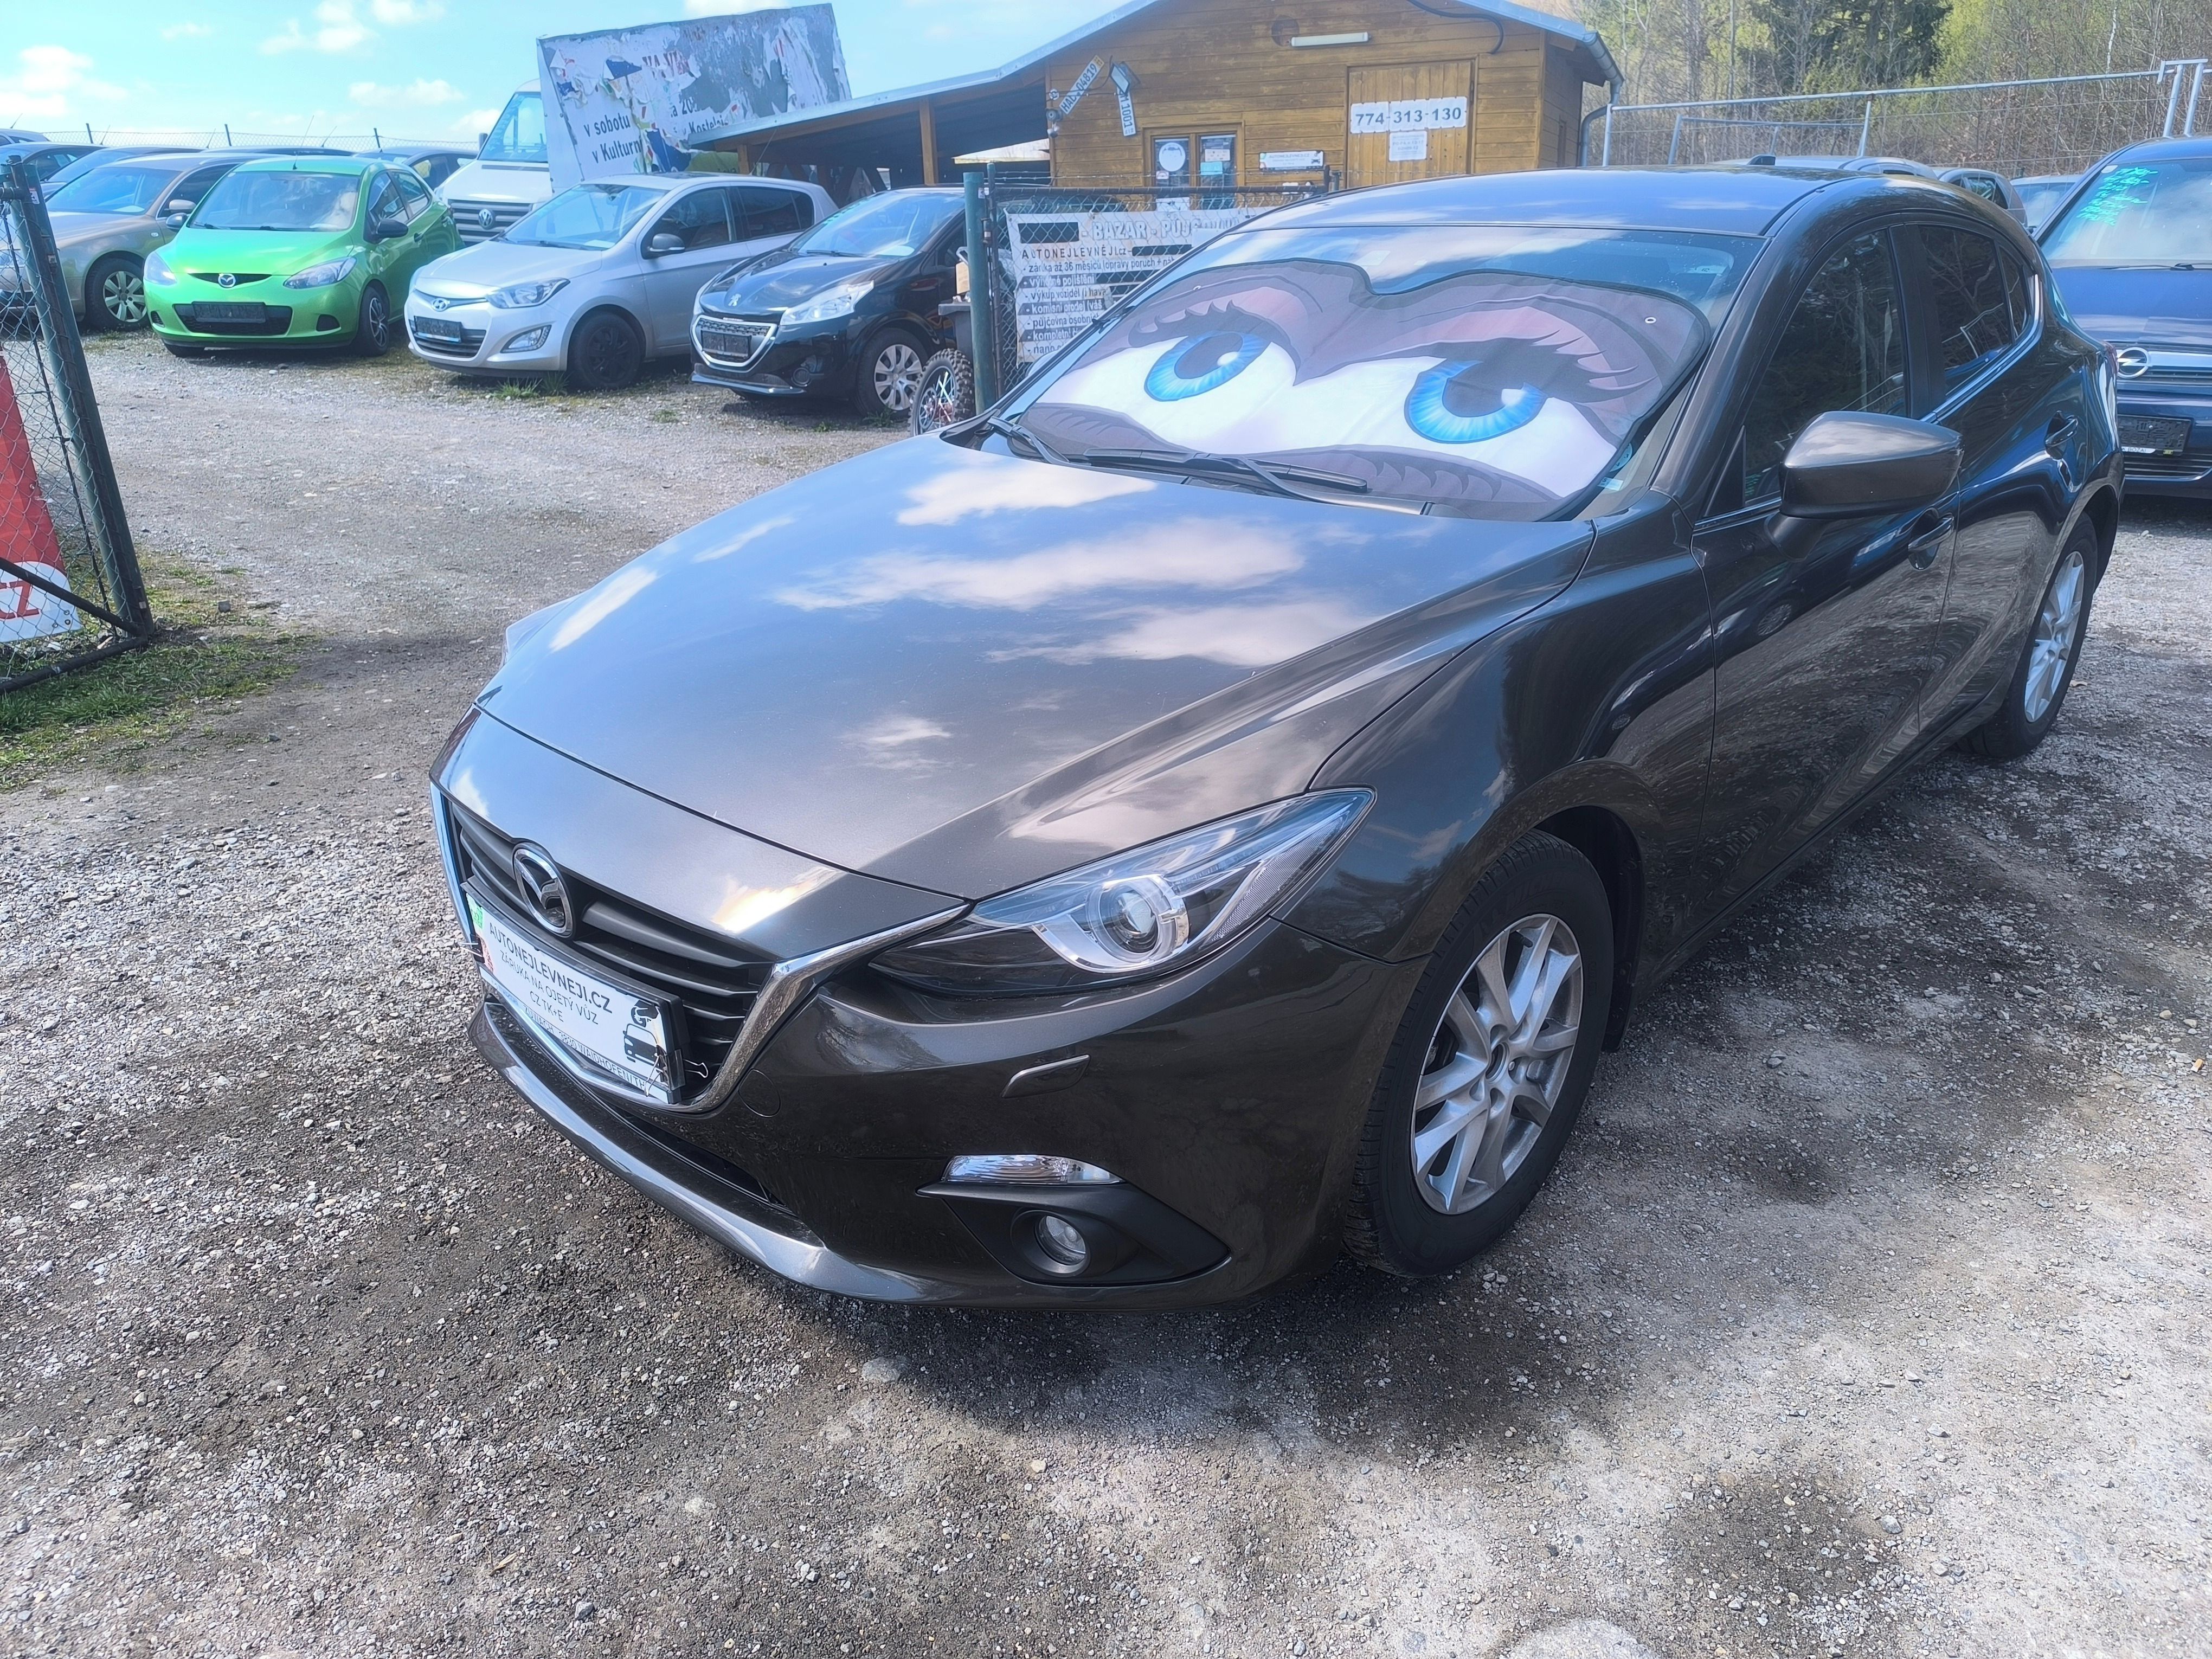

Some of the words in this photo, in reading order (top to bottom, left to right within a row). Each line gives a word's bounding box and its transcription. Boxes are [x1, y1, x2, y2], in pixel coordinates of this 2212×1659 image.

[1076, 63, 1097, 91] 04819
[584, 124, 591, 138] v
[594, 112, 631, 136] sobotu
[1121, 103, 1133, 128] 1001
[591, 151, 599, 164] v
[1092, 220, 1148, 240] BAZAR
[1054, 261, 1063, 272] až
[1064, 261, 1073, 272] 36
[1131, 258, 1155, 269] poruch
[1031, 290, 1055, 303] výkup
[1057, 289, 1080, 299] vozidel
[1033, 317, 1067, 330] půjčovna
[490, 922, 613, 1014] AUTONEJLEVNEJI.CZ
[499, 949, 530, 982] ZÁRUKA
[531, 975, 544, 993] NA
[530, 991, 541, 1006] CZ
[542, 999, 564, 1023] TK+E
[559, 1031, 578, 1050] 3830
